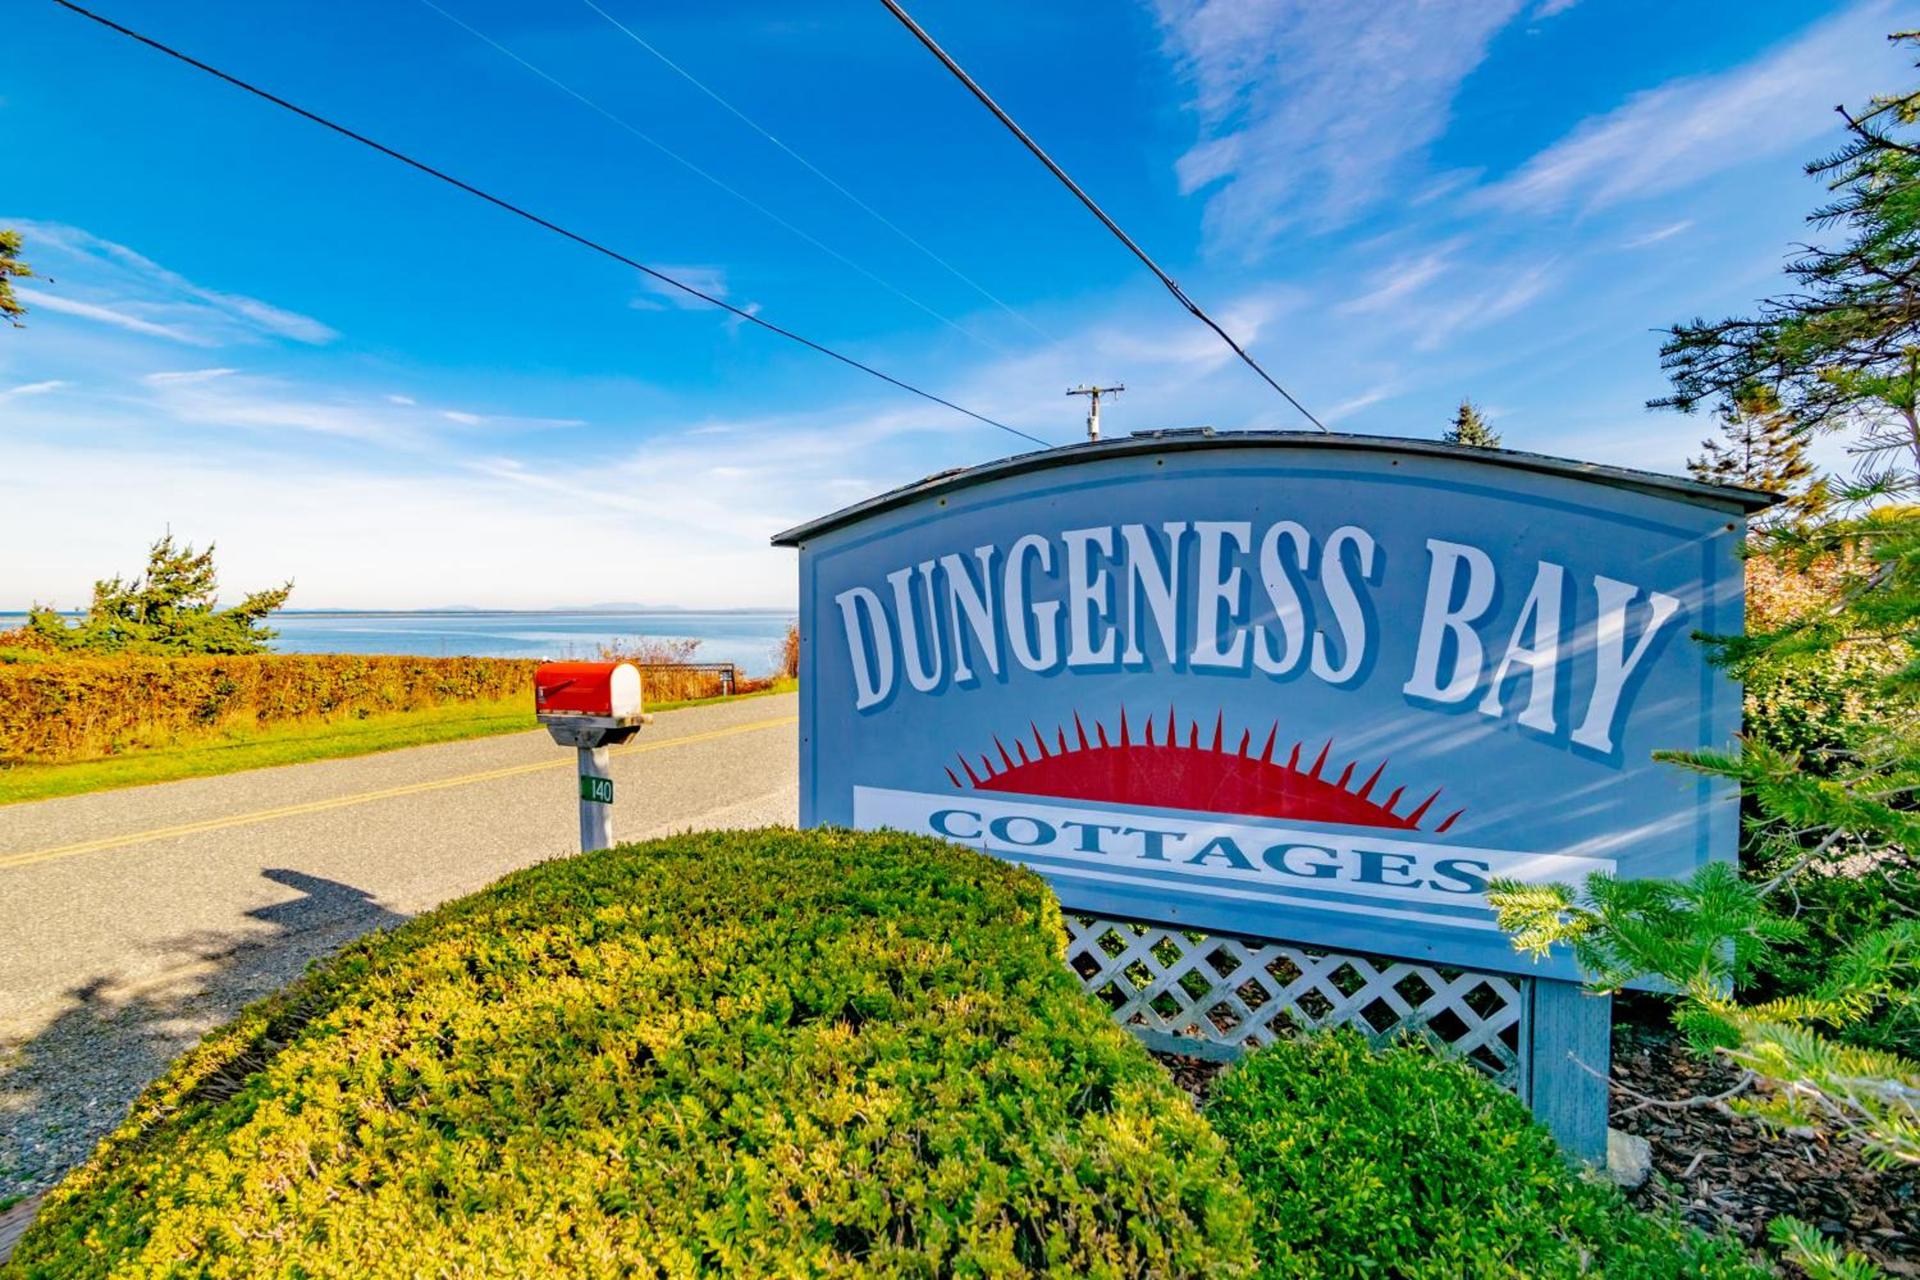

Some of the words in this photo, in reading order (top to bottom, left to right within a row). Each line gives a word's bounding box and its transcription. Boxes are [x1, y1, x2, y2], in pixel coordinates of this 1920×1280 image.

[835, 520, 1376, 711] DUNGENESS
[1402, 538, 1681, 755] BAY
[591, 779, 612, 802] 140
[928, 809, 1491, 895] COTTAGES
